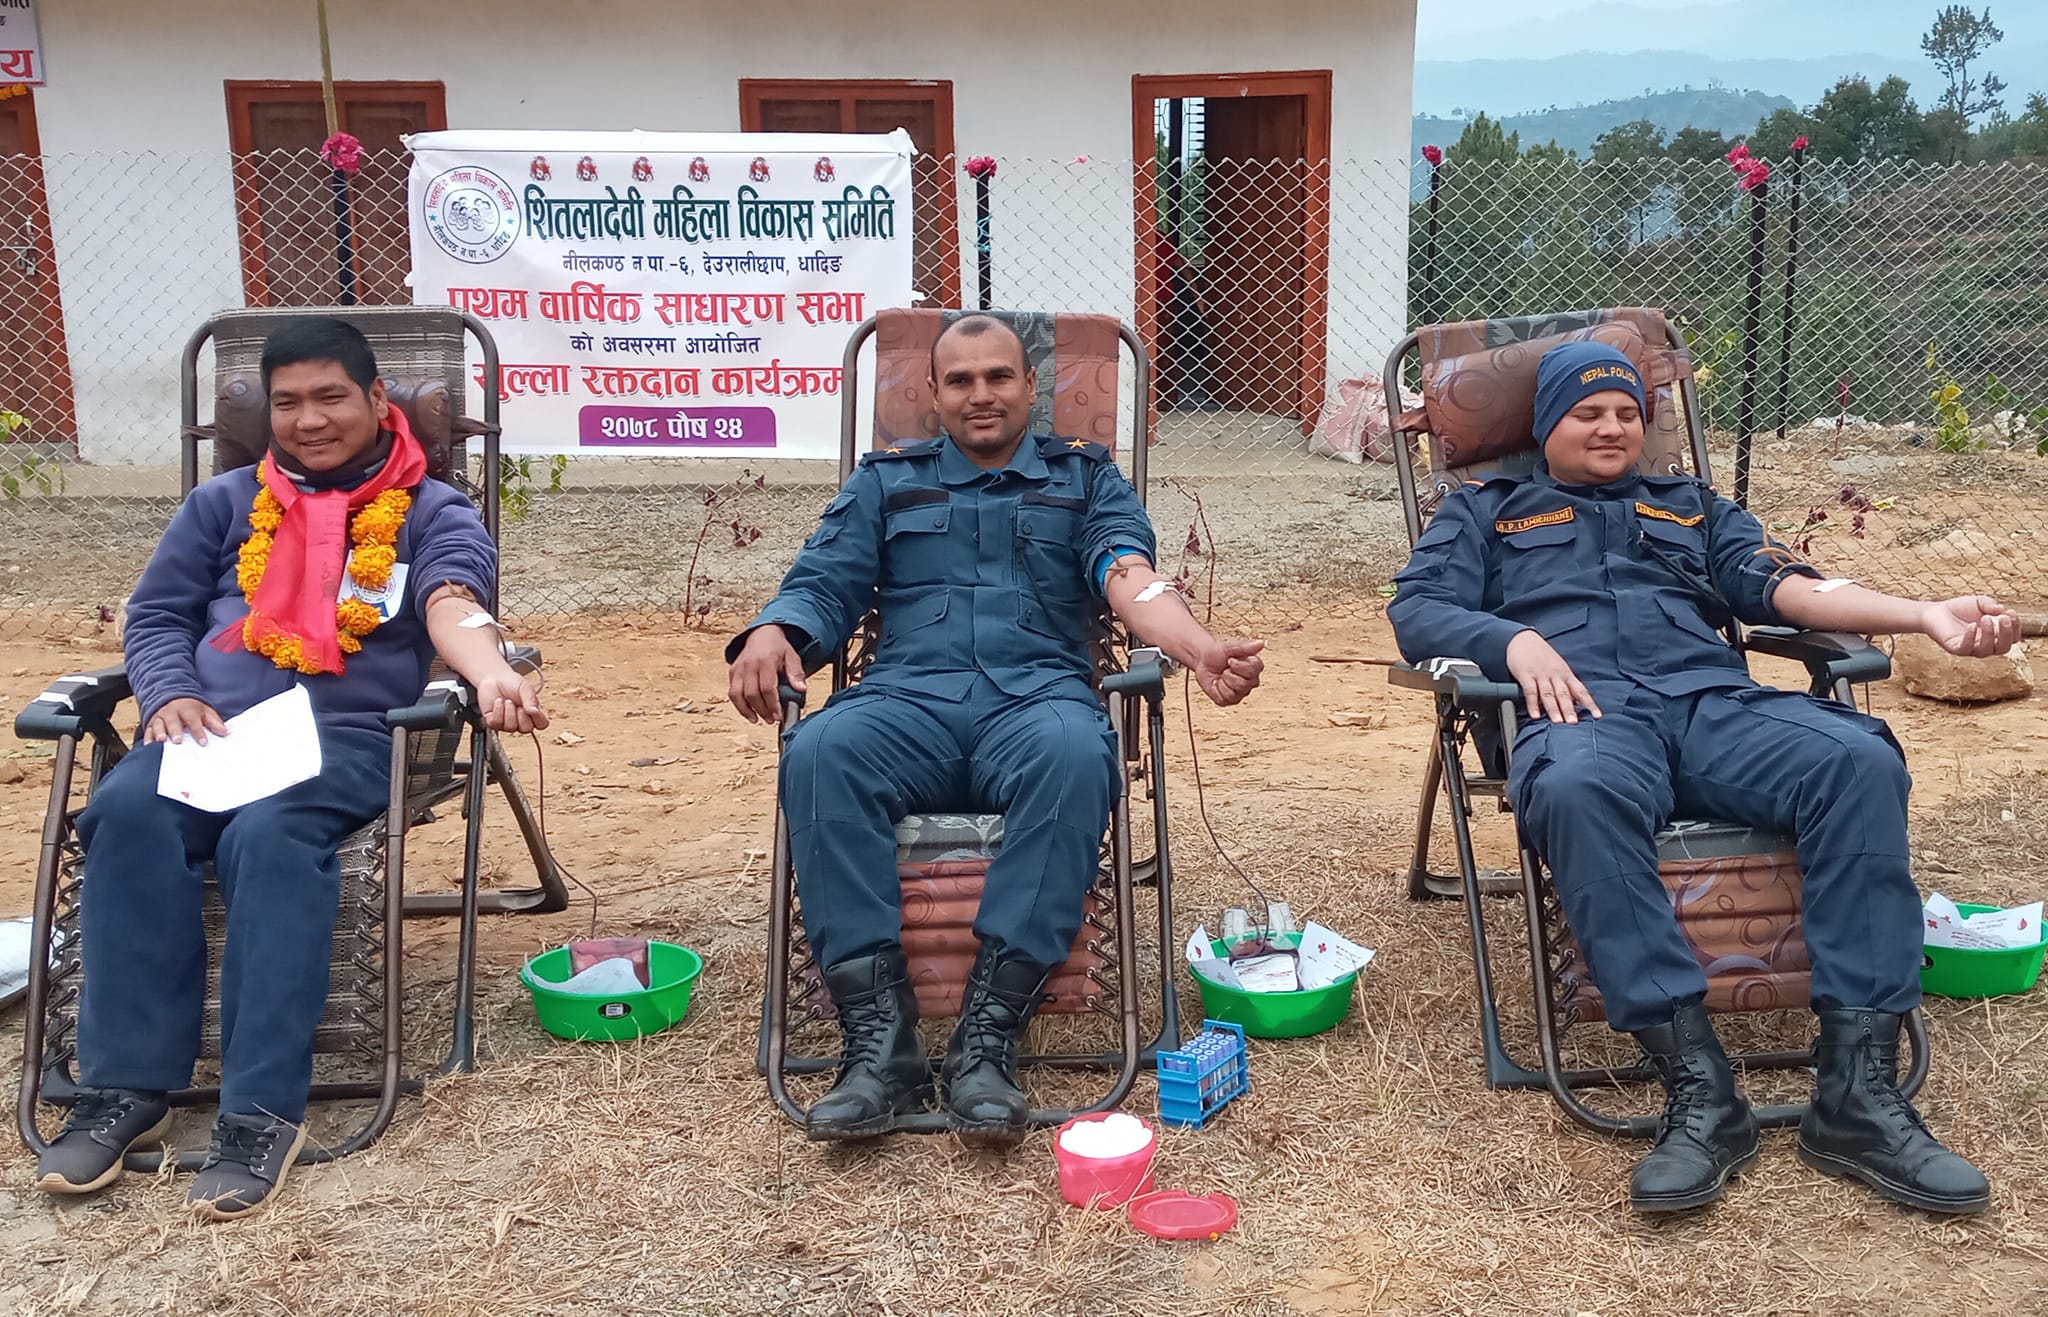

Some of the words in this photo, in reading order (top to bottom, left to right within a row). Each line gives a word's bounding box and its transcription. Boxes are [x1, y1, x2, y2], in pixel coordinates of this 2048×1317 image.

[524, 184, 645, 240] शितलादेवी
[652, 185, 730, 242] महिला
[738, 185, 814, 241] विकास
[822, 185, 895, 241] समिति
[563, 250, 625, 272] नीलकण्ठ
[703, 250, 790, 276] देउरालीछाप,
[798, 250, 843, 273] धादिङ
[539, 281, 642, 322] वार्षिक
[654, 293, 785, 325] साधारण
[796, 291, 865, 324] सभा
[570, 331, 593, 351] को
[603, 336, 676, 356] अवसरमा
[686, 331, 761, 354] आयोजित
[581, 365, 701, 398] रक्तदान
[711, 358, 844, 396] कार्यक्रम
[1580, 367, 1609, 385] NEPAL
[601, 416, 659, 438] २०७८
[667, 411, 708, 439] पौष
[714, 417, 744, 439] २४
